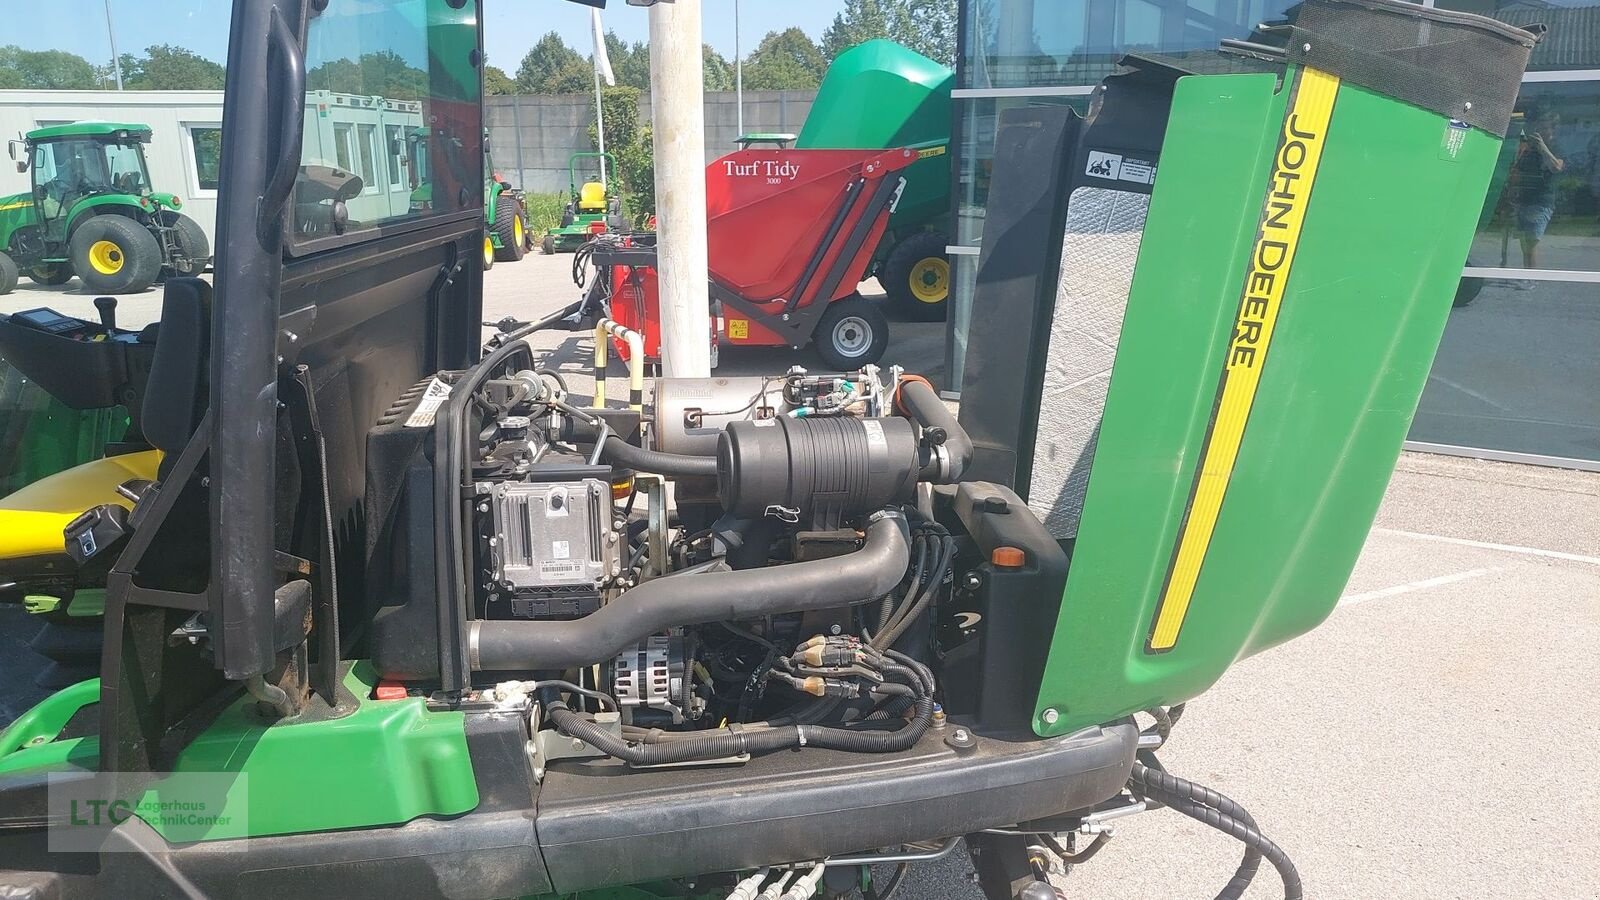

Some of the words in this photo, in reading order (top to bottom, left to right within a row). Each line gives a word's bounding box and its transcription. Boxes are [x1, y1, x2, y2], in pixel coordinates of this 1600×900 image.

[723, 161, 760, 176] Turf
[763, 161, 800, 180] Tidy
[1266, 114, 1315, 229] JOHN
[1231, 241, 1288, 368] DEERE
